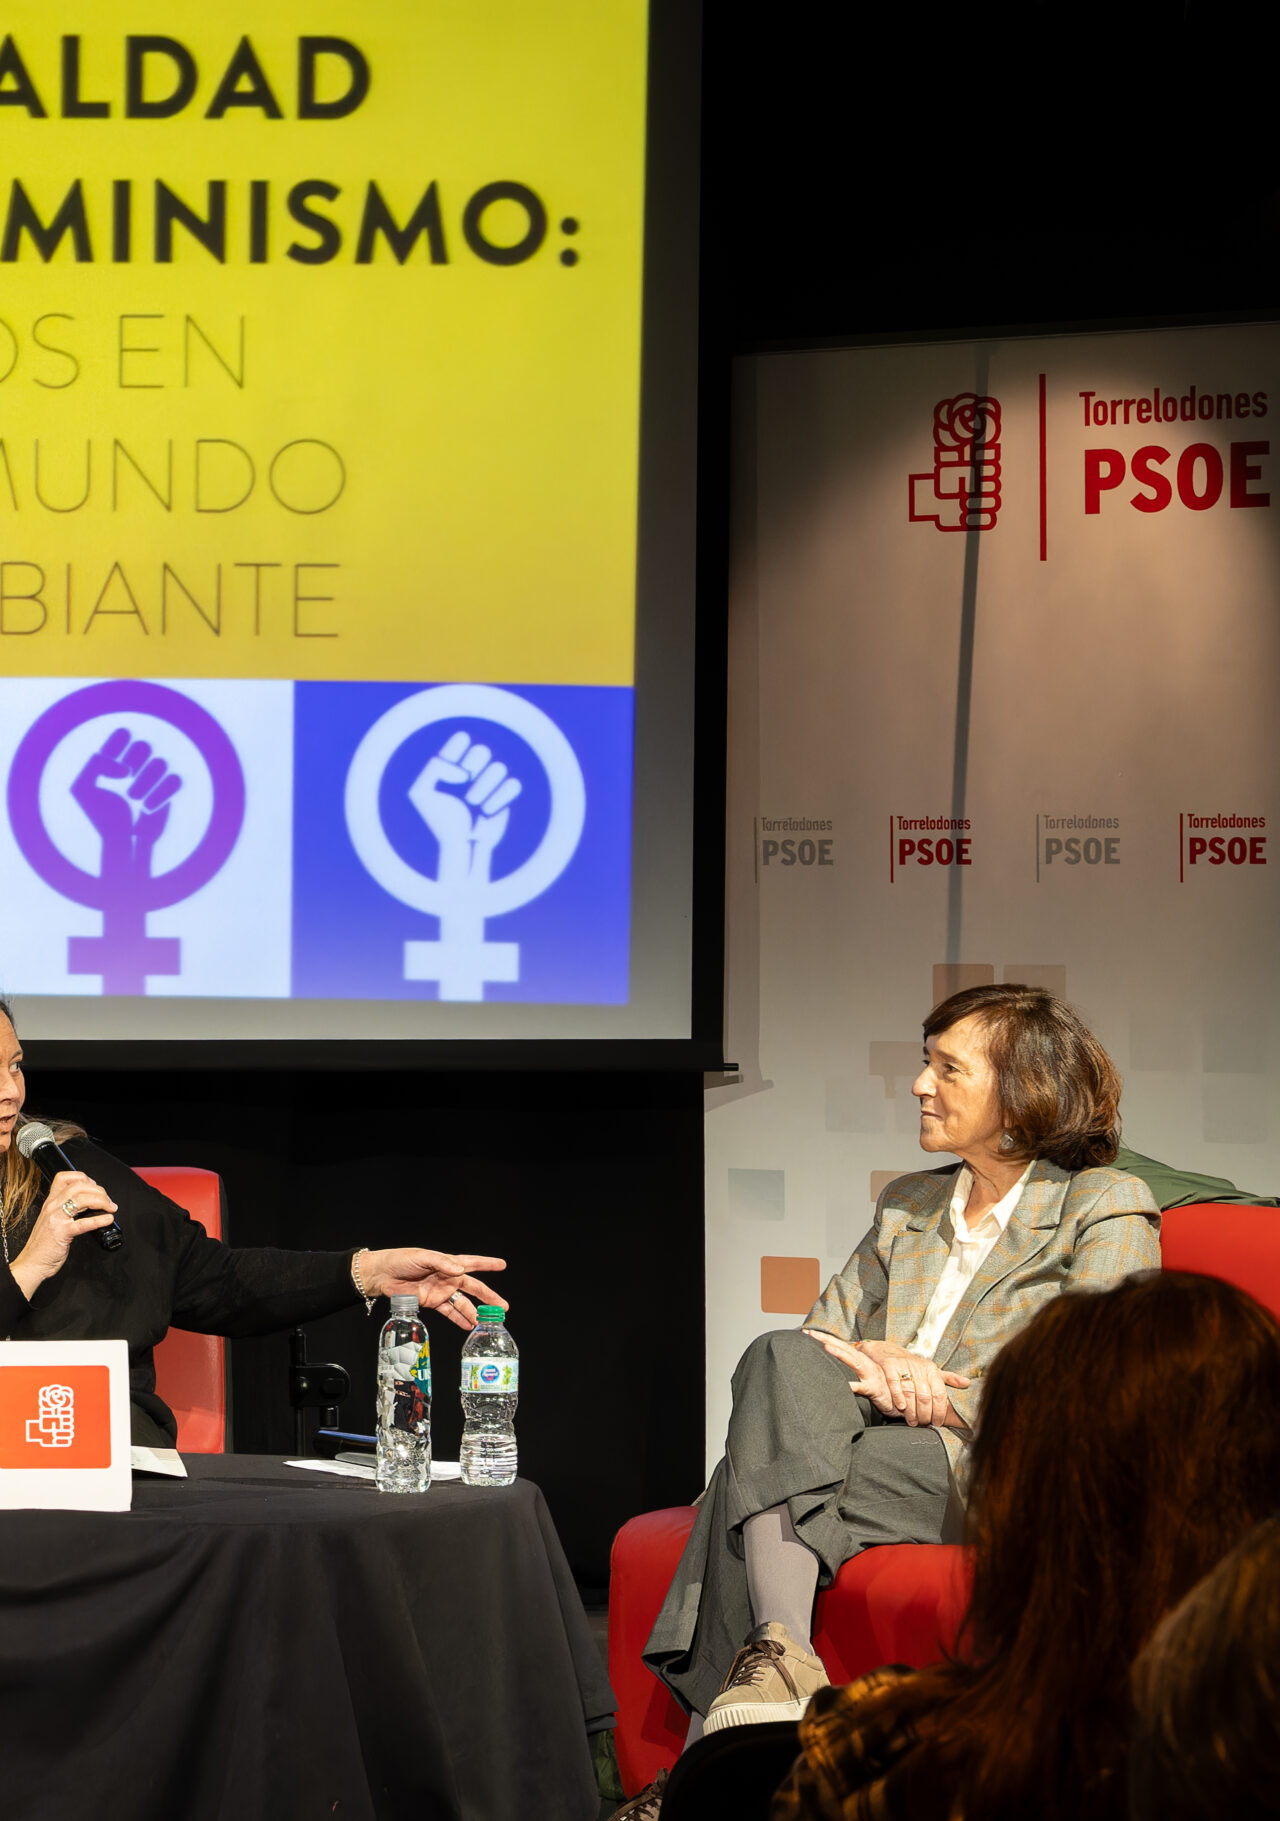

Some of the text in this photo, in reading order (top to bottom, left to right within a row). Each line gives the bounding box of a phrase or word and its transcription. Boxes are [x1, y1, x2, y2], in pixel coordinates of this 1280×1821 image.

[119, 314, 246, 389] EN
[1079, 385, 1269, 427] Torrelodones
[1084, 440, 1271, 515] PSOE
[761, 817, 833, 833] Torrelodones
[897, 815, 972, 832] Torrelodones
[1044, 814, 1120, 831] Torrelodones
[1187, 813, 1267, 830] Torrelodones
[762, 839, 834, 867] PSOE
[898, 838, 972, 866] PSOE
[1045, 837, 1120, 865] PSOE
[1188, 836, 1267, 865] PSOE
